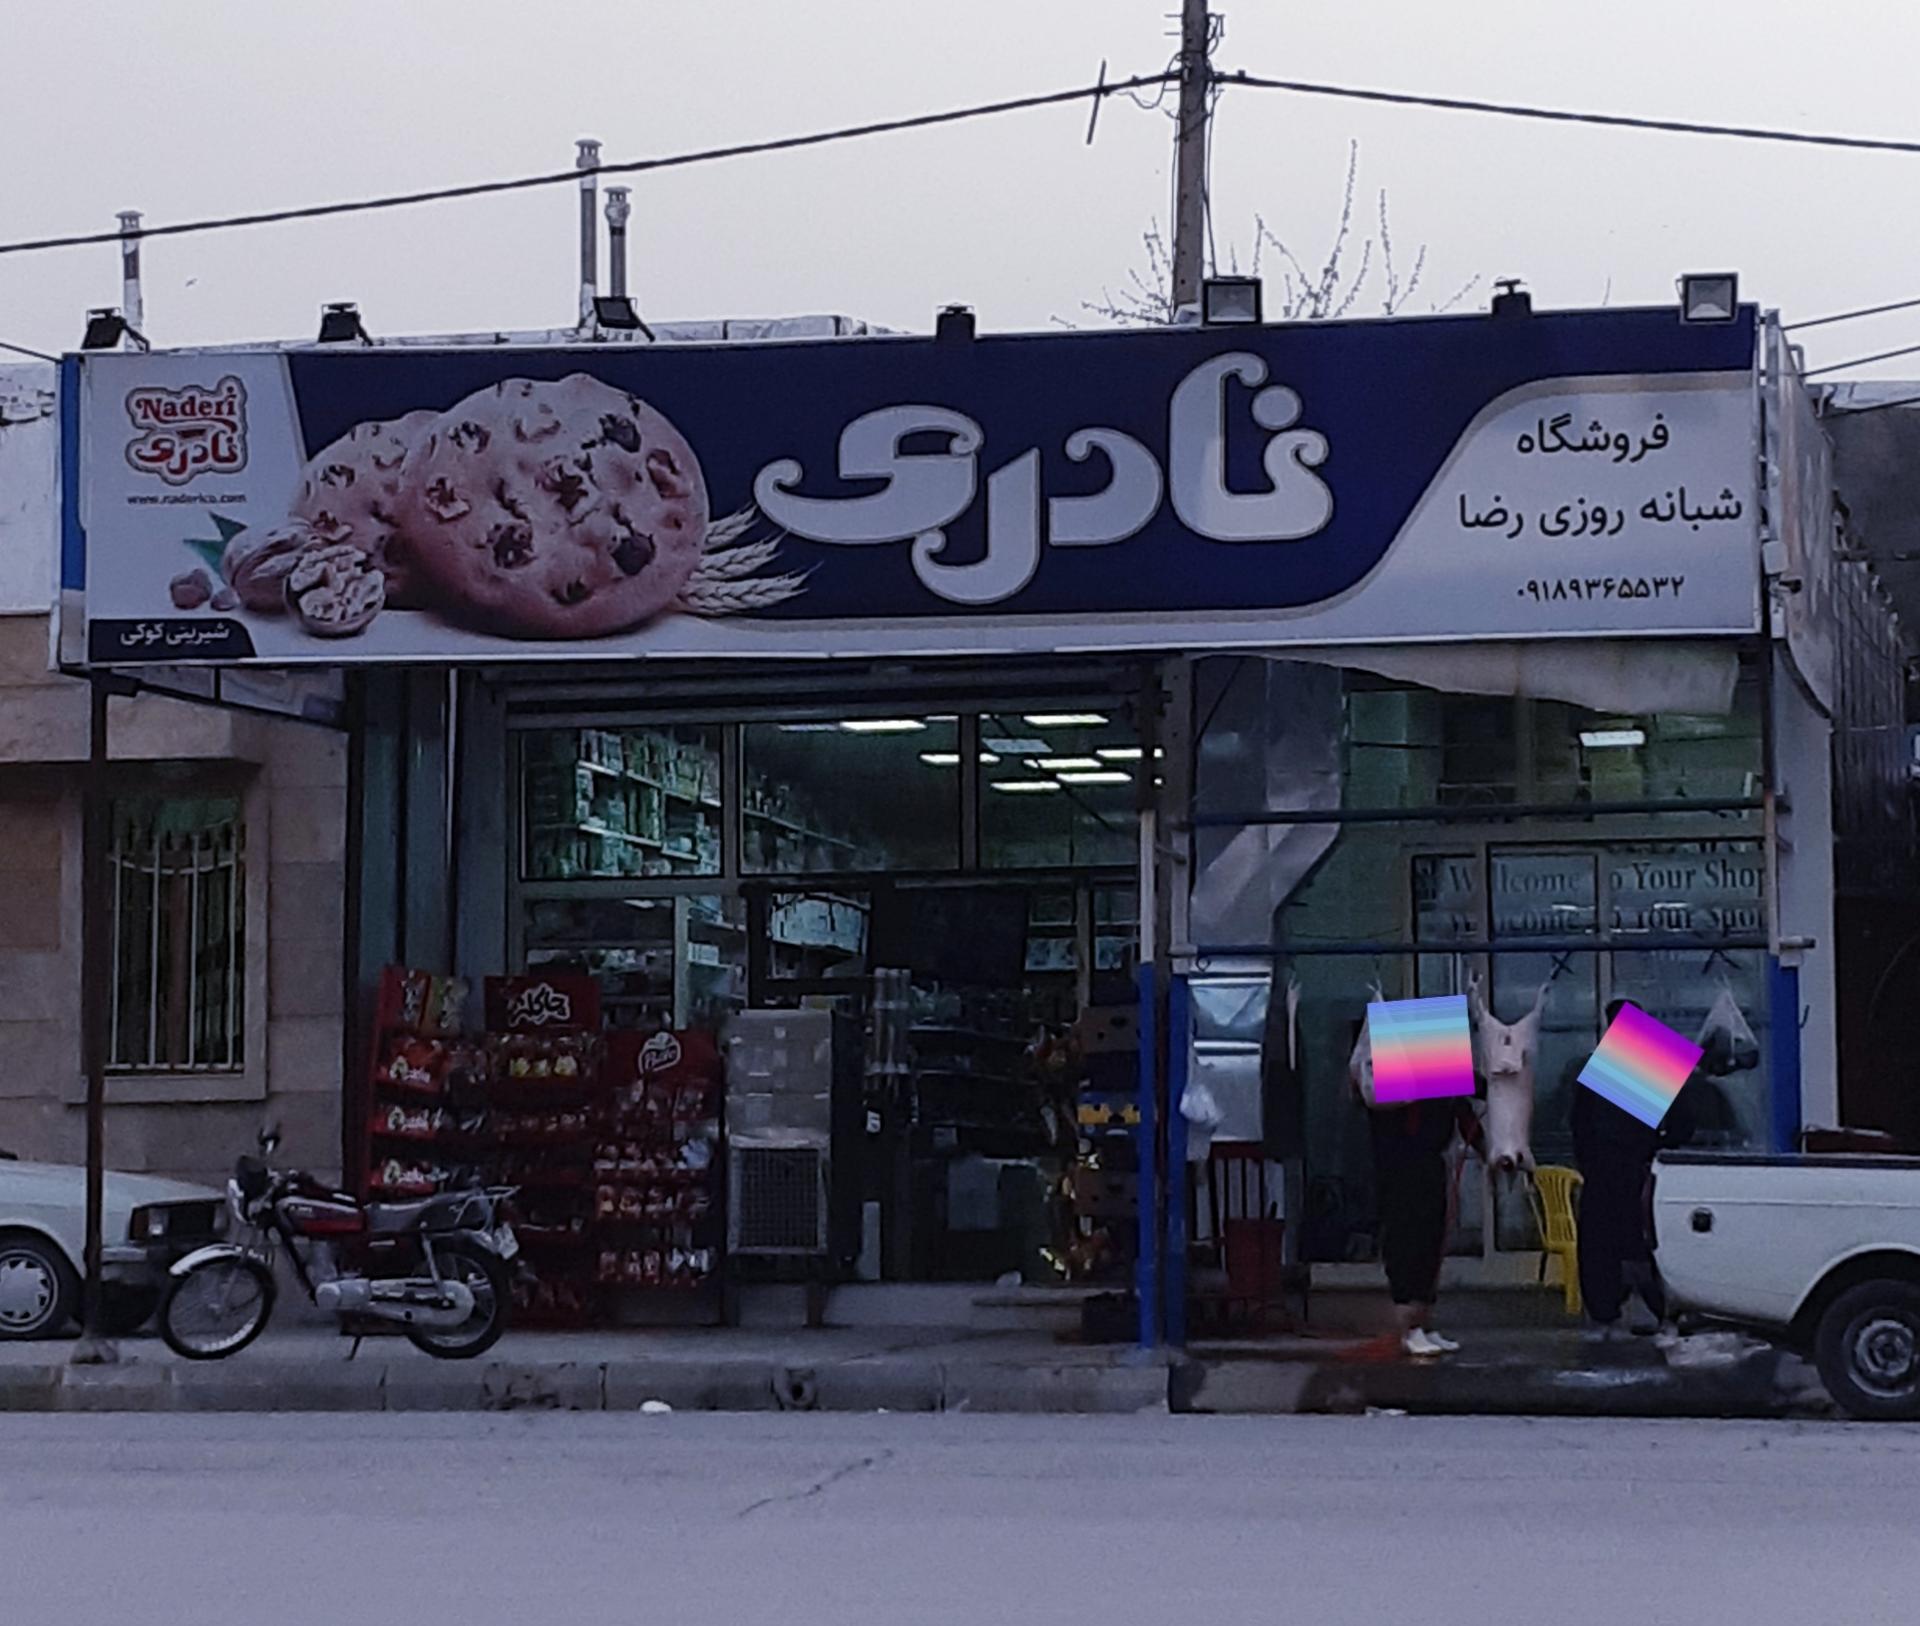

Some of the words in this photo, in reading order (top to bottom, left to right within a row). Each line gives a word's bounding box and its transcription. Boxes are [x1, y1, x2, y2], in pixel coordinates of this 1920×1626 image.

[136, 386, 237, 430] Naderi
[136, 431, 238, 475] نادری
[1517, 412, 1670, 463] فروشگاه
[753, 352, 1335, 605] نادری
[1458, 494, 1524, 539] رضا
[1539, 498, 1625, 537] روزی
[1640, 486, 1743, 532] شبانه
[1516, 575, 1685, 602] ۰۹۱۸۹۳۶۵۵۳۲
[119, 623, 165, 646] کوکی
[165, 622, 231, 646] شیرینی
[1448, 863, 1580, 893] Wlcome
[1632, 862, 1696, 889] Your
